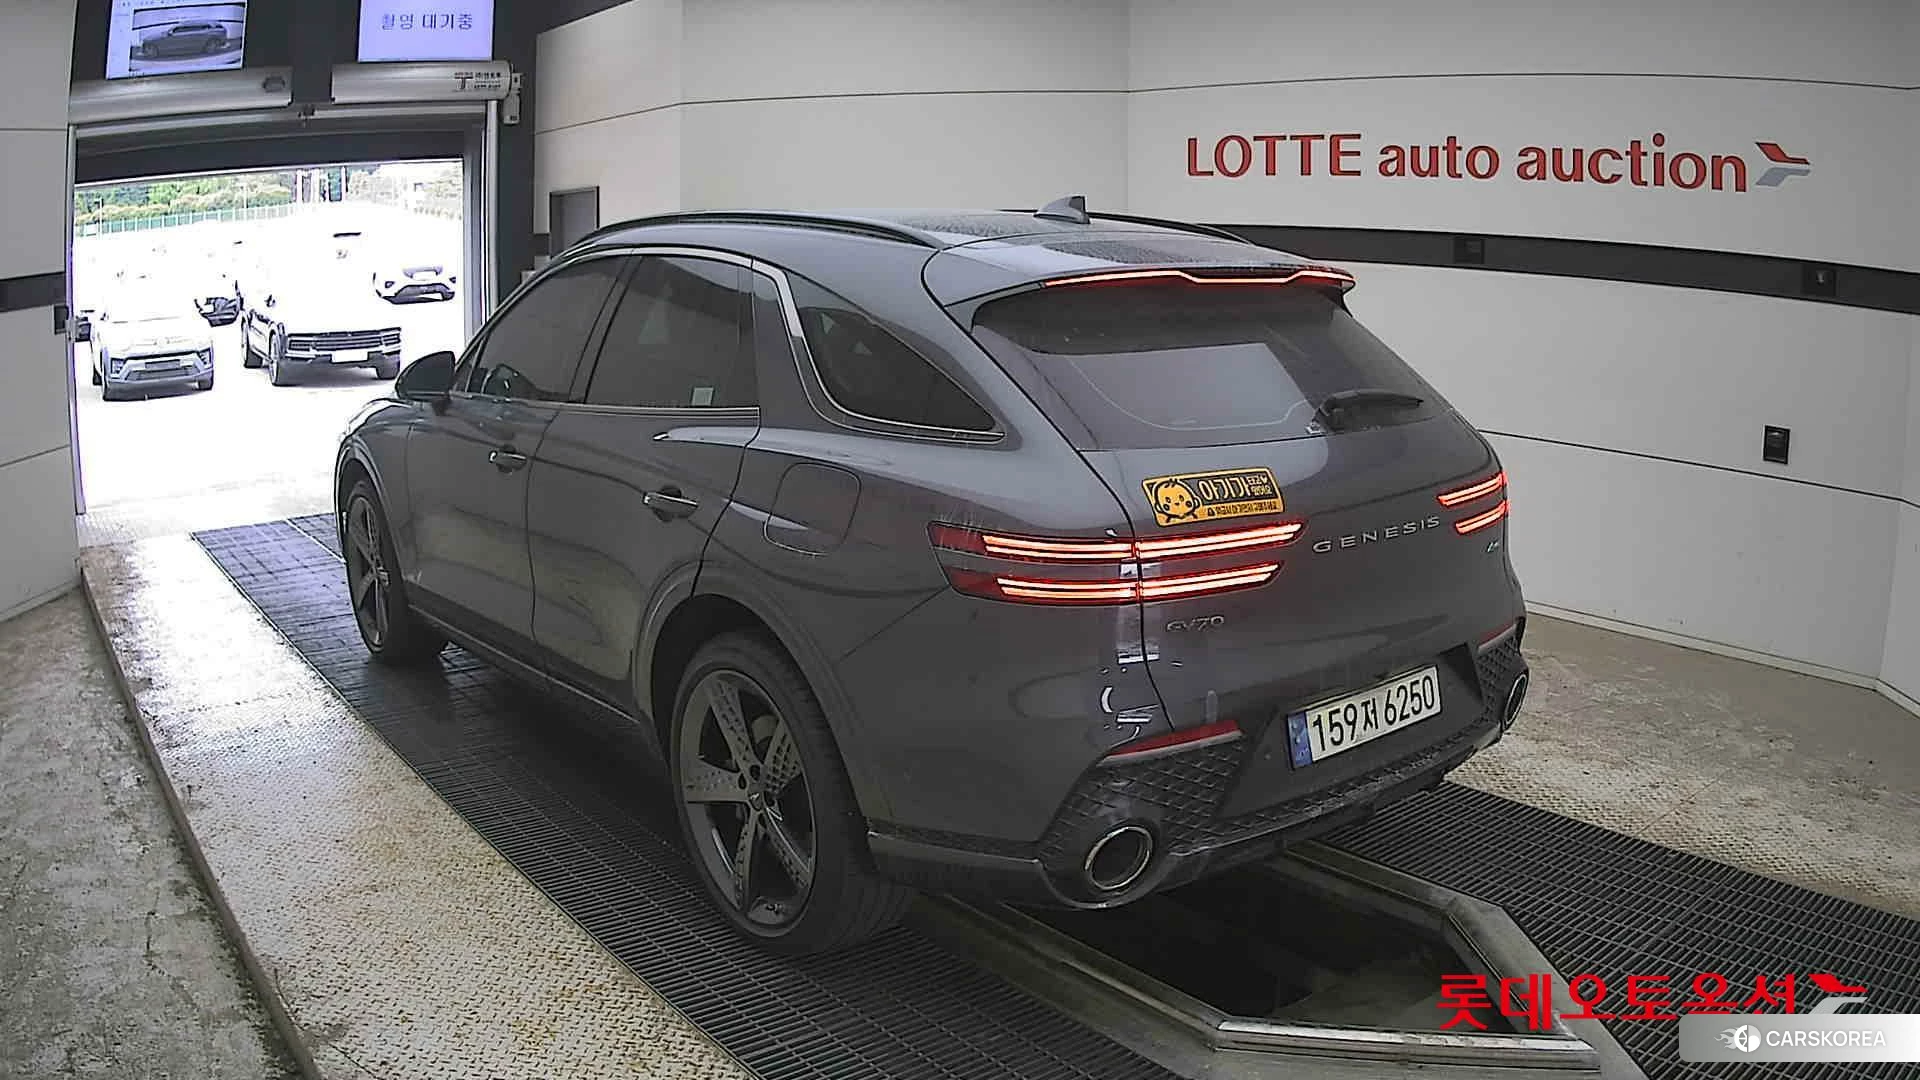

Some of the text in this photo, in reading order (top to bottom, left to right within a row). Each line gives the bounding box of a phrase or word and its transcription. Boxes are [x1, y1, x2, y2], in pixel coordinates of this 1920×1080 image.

[422, 13, 473, 30] 대기중
[1186, 132, 1748, 193] LOTTE auto auction
[1198, 476, 1251, 501] 아기가
[1312, 516, 1440, 553] GENESIS
[1312, 675, 1435, 751] 159저 6250
